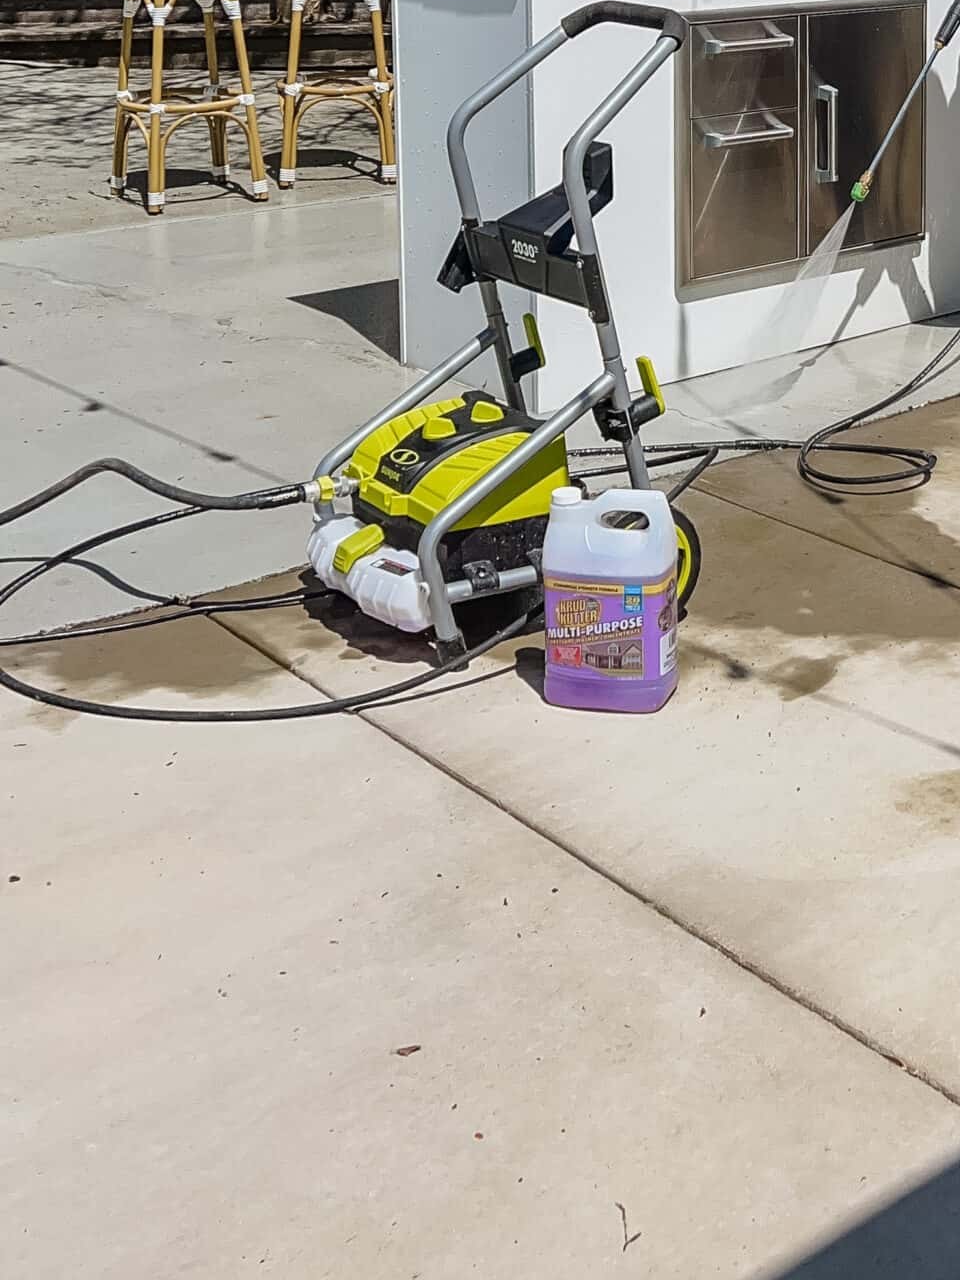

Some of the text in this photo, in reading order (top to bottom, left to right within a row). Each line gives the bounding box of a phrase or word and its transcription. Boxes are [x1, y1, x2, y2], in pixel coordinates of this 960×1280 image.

[560, 599, 586, 612] KRUD
[560, 610, 597, 625] KUTTER
[547, 616, 643, 639] MULTI-PURPOSE
